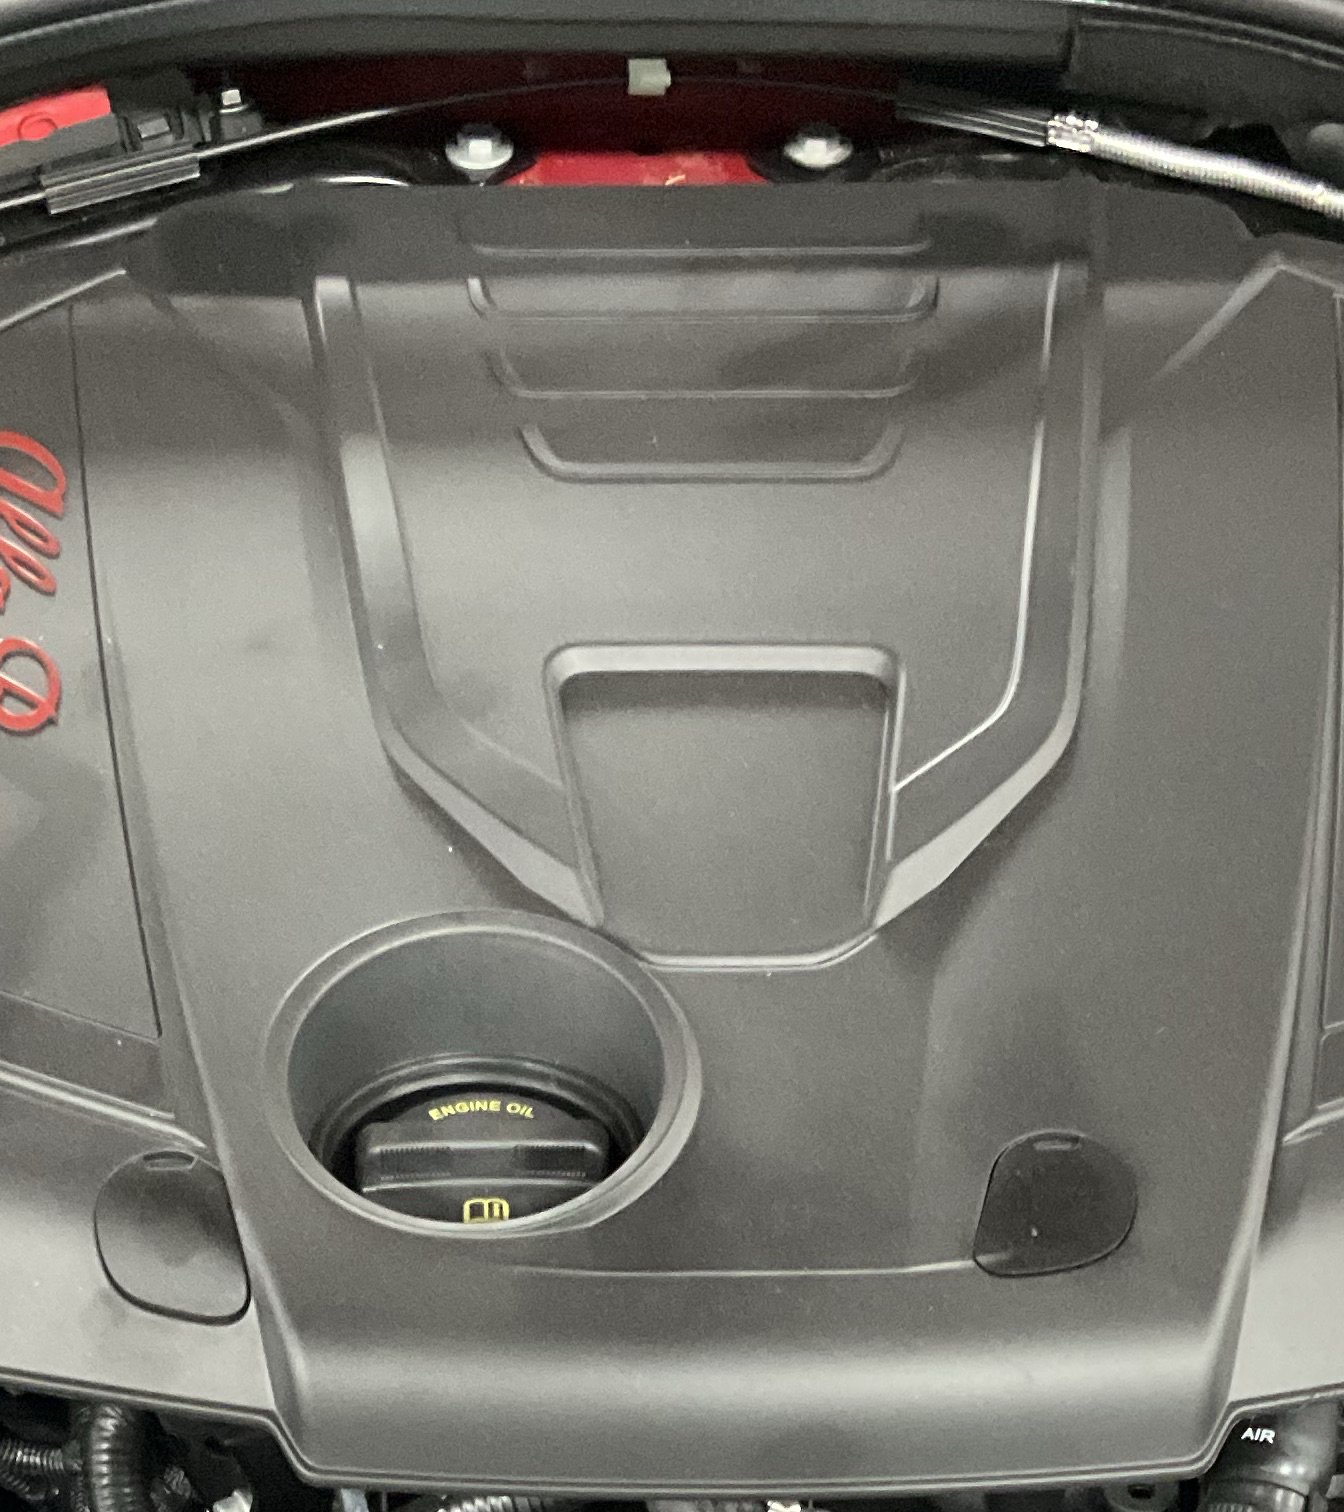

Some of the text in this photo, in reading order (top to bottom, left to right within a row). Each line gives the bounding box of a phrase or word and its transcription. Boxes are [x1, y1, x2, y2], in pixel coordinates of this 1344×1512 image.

[428, 1099, 534, 1120] ENGINE OIL
[1240, 1426, 1276, 1445] AIR
